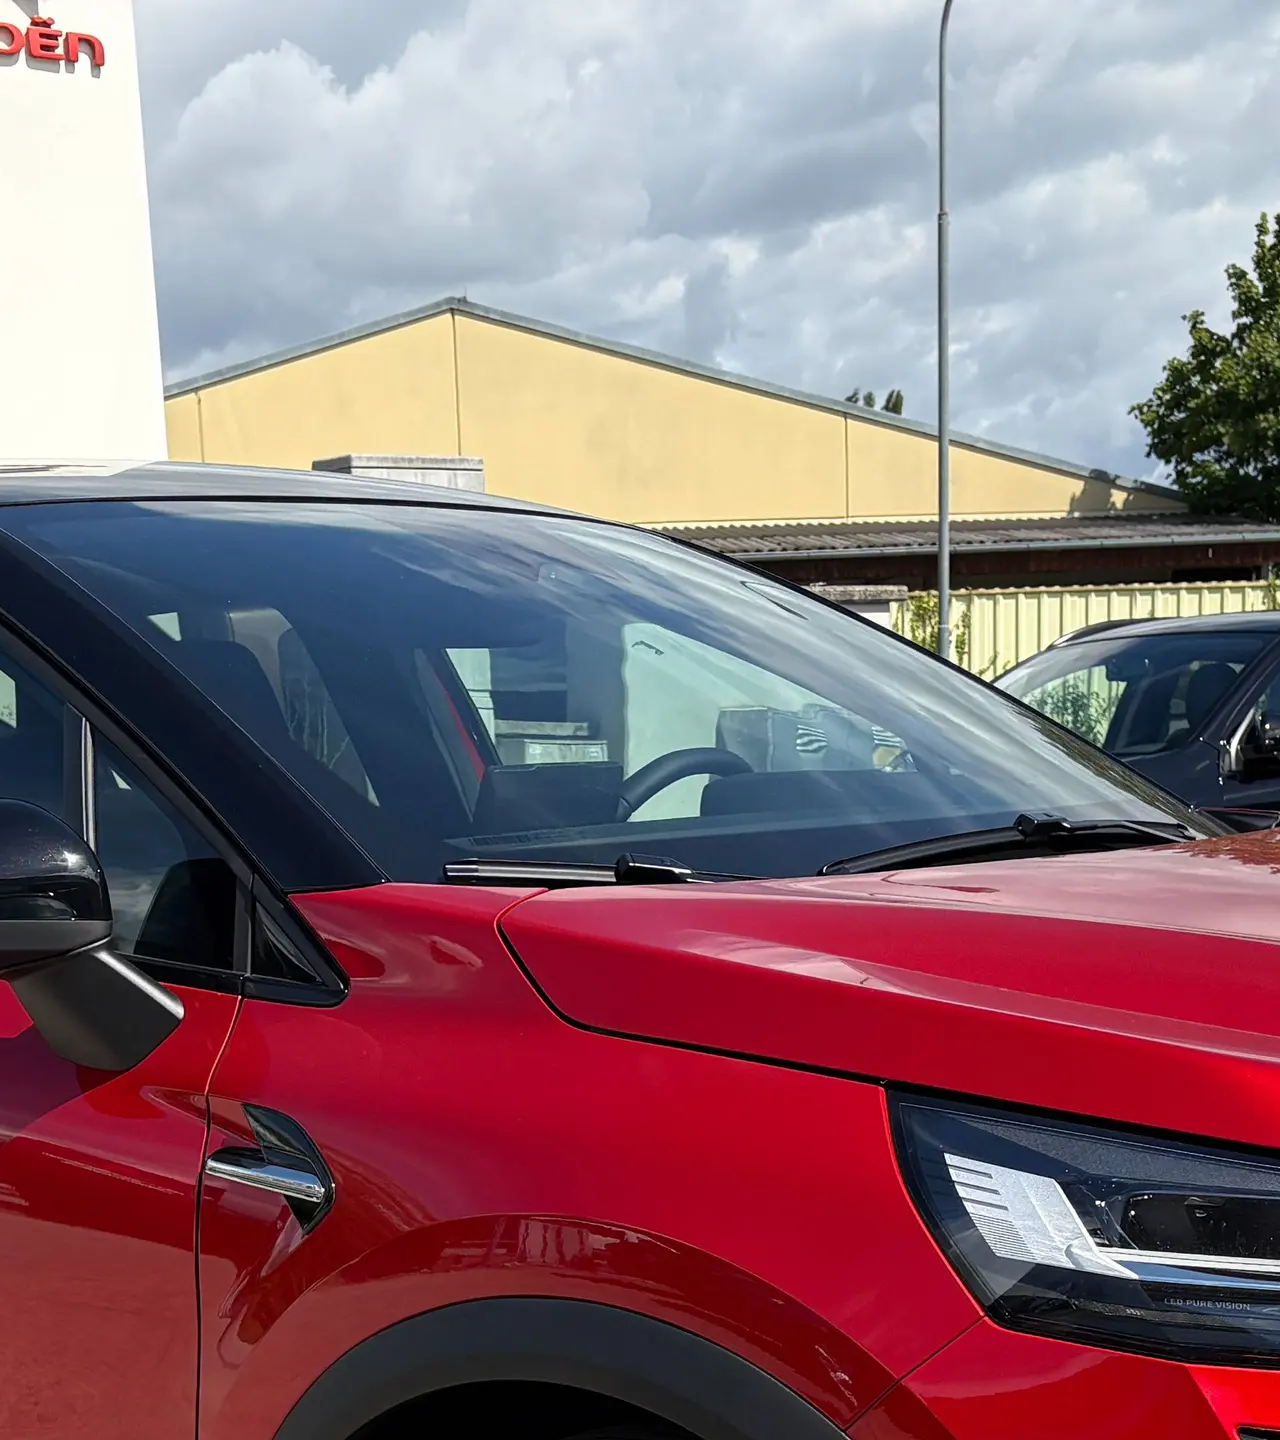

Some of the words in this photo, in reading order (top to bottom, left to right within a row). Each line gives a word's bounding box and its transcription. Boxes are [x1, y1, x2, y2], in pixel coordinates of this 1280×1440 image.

[1164, 1297, 1183, 1306] LED
[1186, 1299, 1213, 1308] PURE
[1215, 1301, 1251, 1311] VISION
